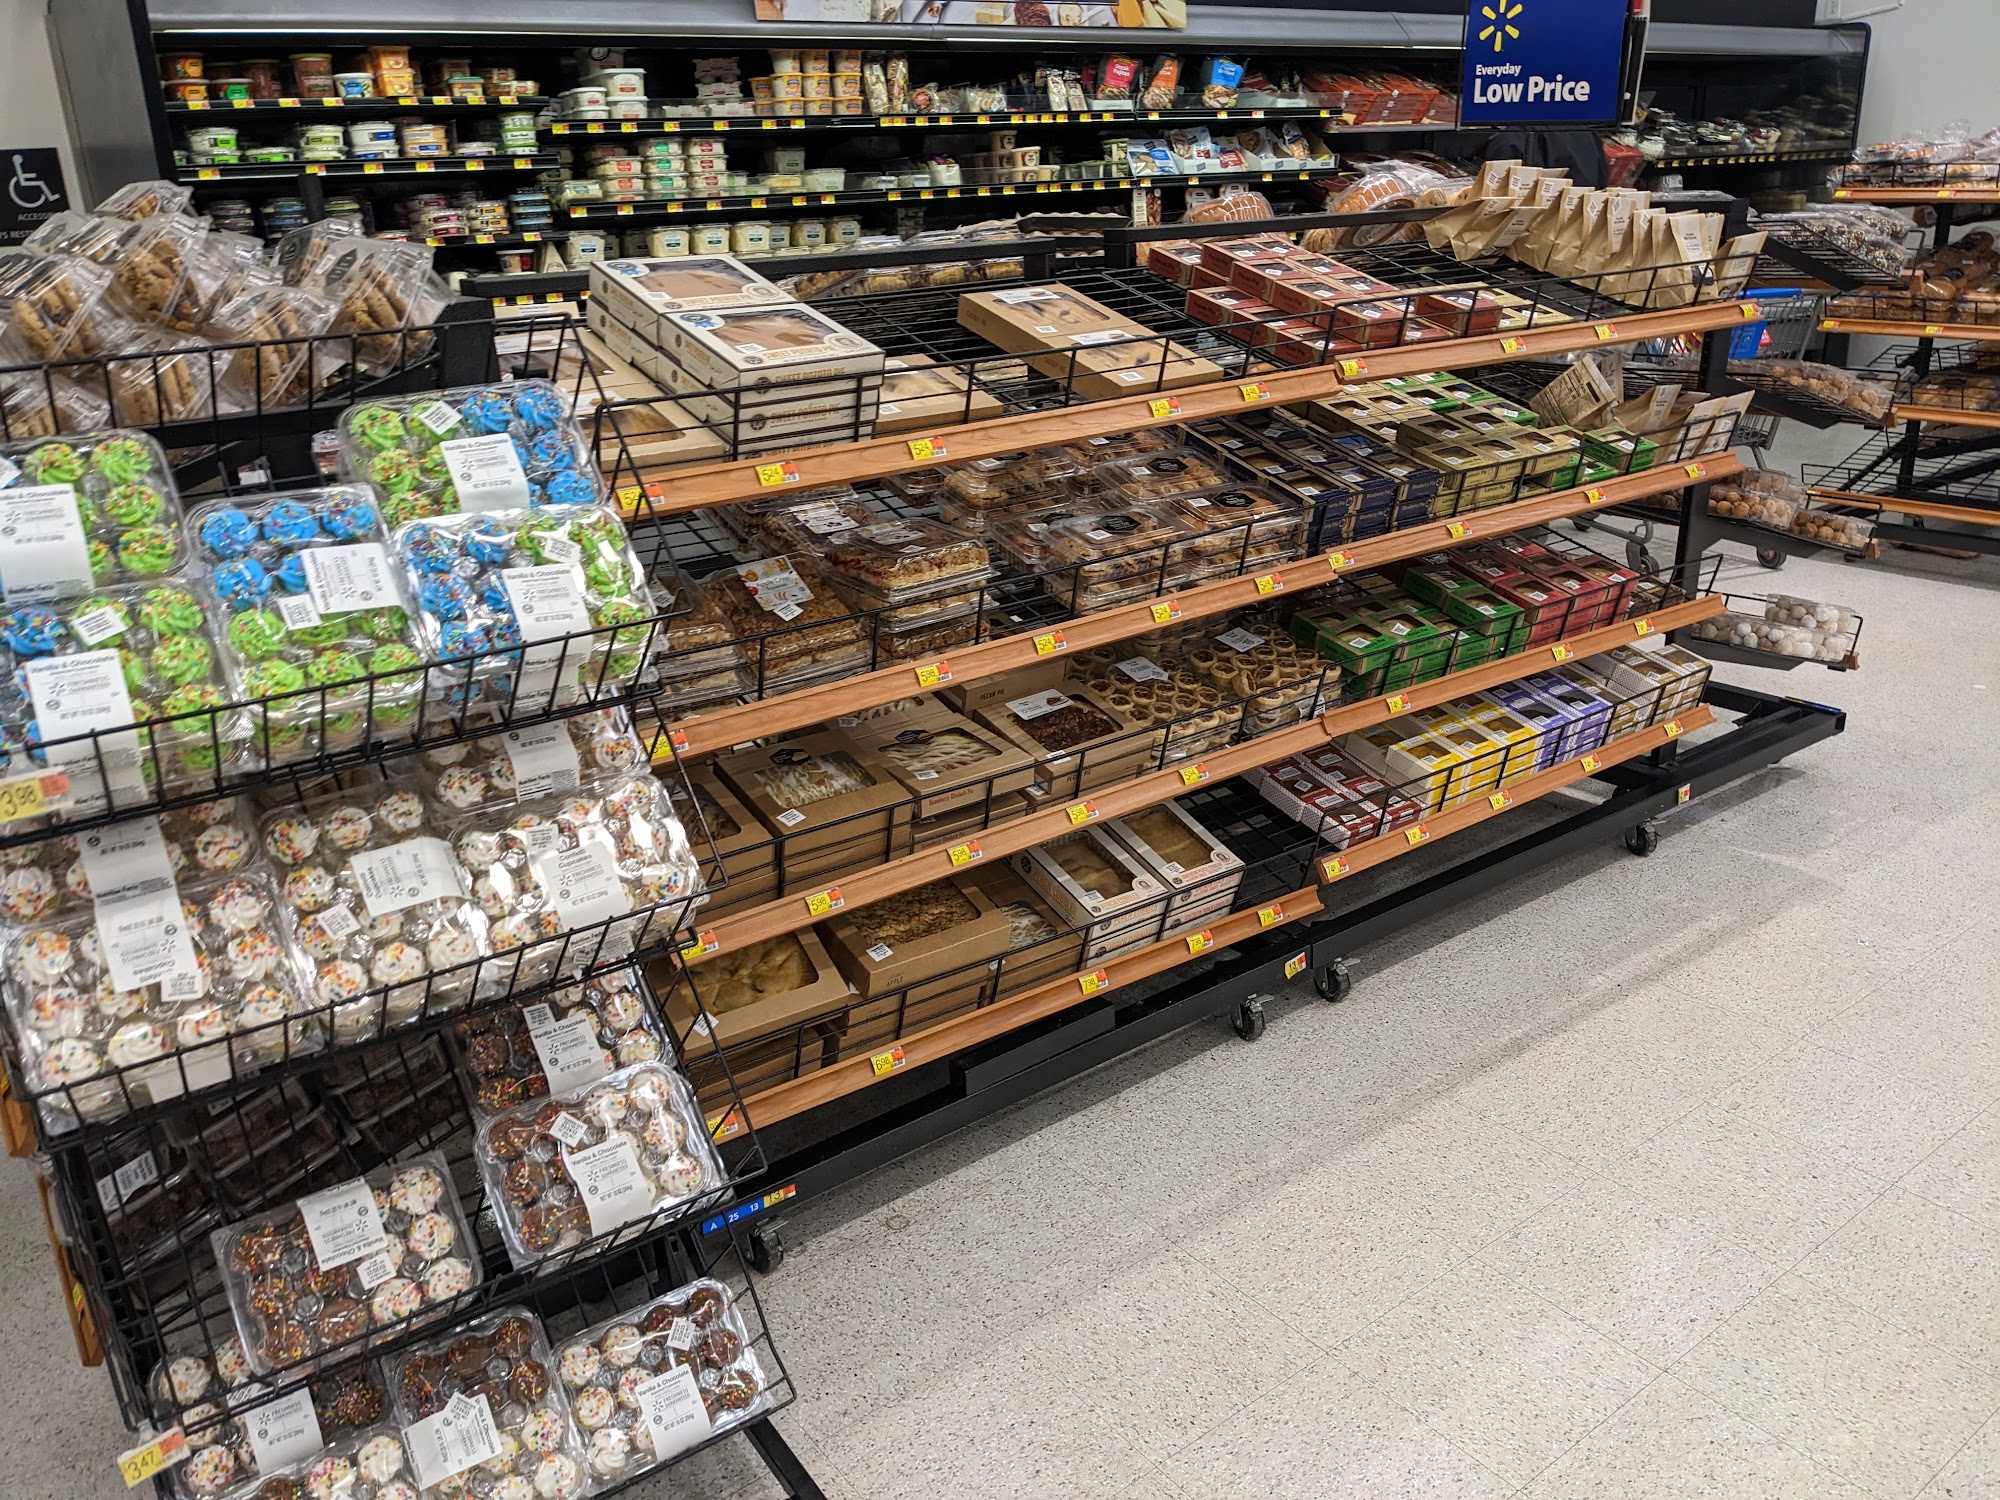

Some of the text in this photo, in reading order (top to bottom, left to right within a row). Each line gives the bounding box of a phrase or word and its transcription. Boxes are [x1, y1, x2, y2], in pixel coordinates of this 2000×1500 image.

[1113, 68, 1130, 76] Fajitas
[1476, 63, 1521, 77] Everyday
[1474, 74, 1590, 104] Low Price
[803, 368, 832, 380] POTATO
[771, 403, 840, 423] SWEET POTATO PIE
[914, 442, 930, 456] 524
[762, 470, 780, 482] 524
[536, 569, 571, 578] Chocolate
[1155, 606, 1167, 619] 524
[1039, 638, 1052, 650] 524
[921, 669, 936, 682] 598
[980, 688, 1005, 700] PECAN PIE
[928, 796, 950, 806] Strawberry
[1072, 808, 1085, 820] 598
[558, 848, 586, 861] Confetti
[558, 854, 592, 868] Cupcakes
[953, 848, 966, 862] 598
[811, 896, 826, 911] 598
[1052, 886, 1077, 915] COBBLER
[1100, 892, 1140, 910] PEACH COBBLER
[1190, 938, 1202, 949] 798
[886, 976, 904, 987] APPLE
[1083, 978, 1096, 990] 798
[534, 1030, 552, 1040] Vanilla
[558, 1018, 586, 1030] Chocolate
[875, 1056, 890, 1070] 698
[572, 1154, 592, 1166] Vanilla
[597, 1141, 627, 1156] Chocolate
[710, 1202, 759, 1231] A 25 13
[362, 1238, 384, 1248] Vanilla
[321, 1248, 356, 1266] Chocolate
[638, 1385, 656, 1396] Vanilla
[662, 1370, 690, 1386] Chocolate
[662, 1388, 688, 1404] FRESHNESS
[482, 1424, 496, 1454] Chocolate
[128, 1451, 154, 1480] 347
